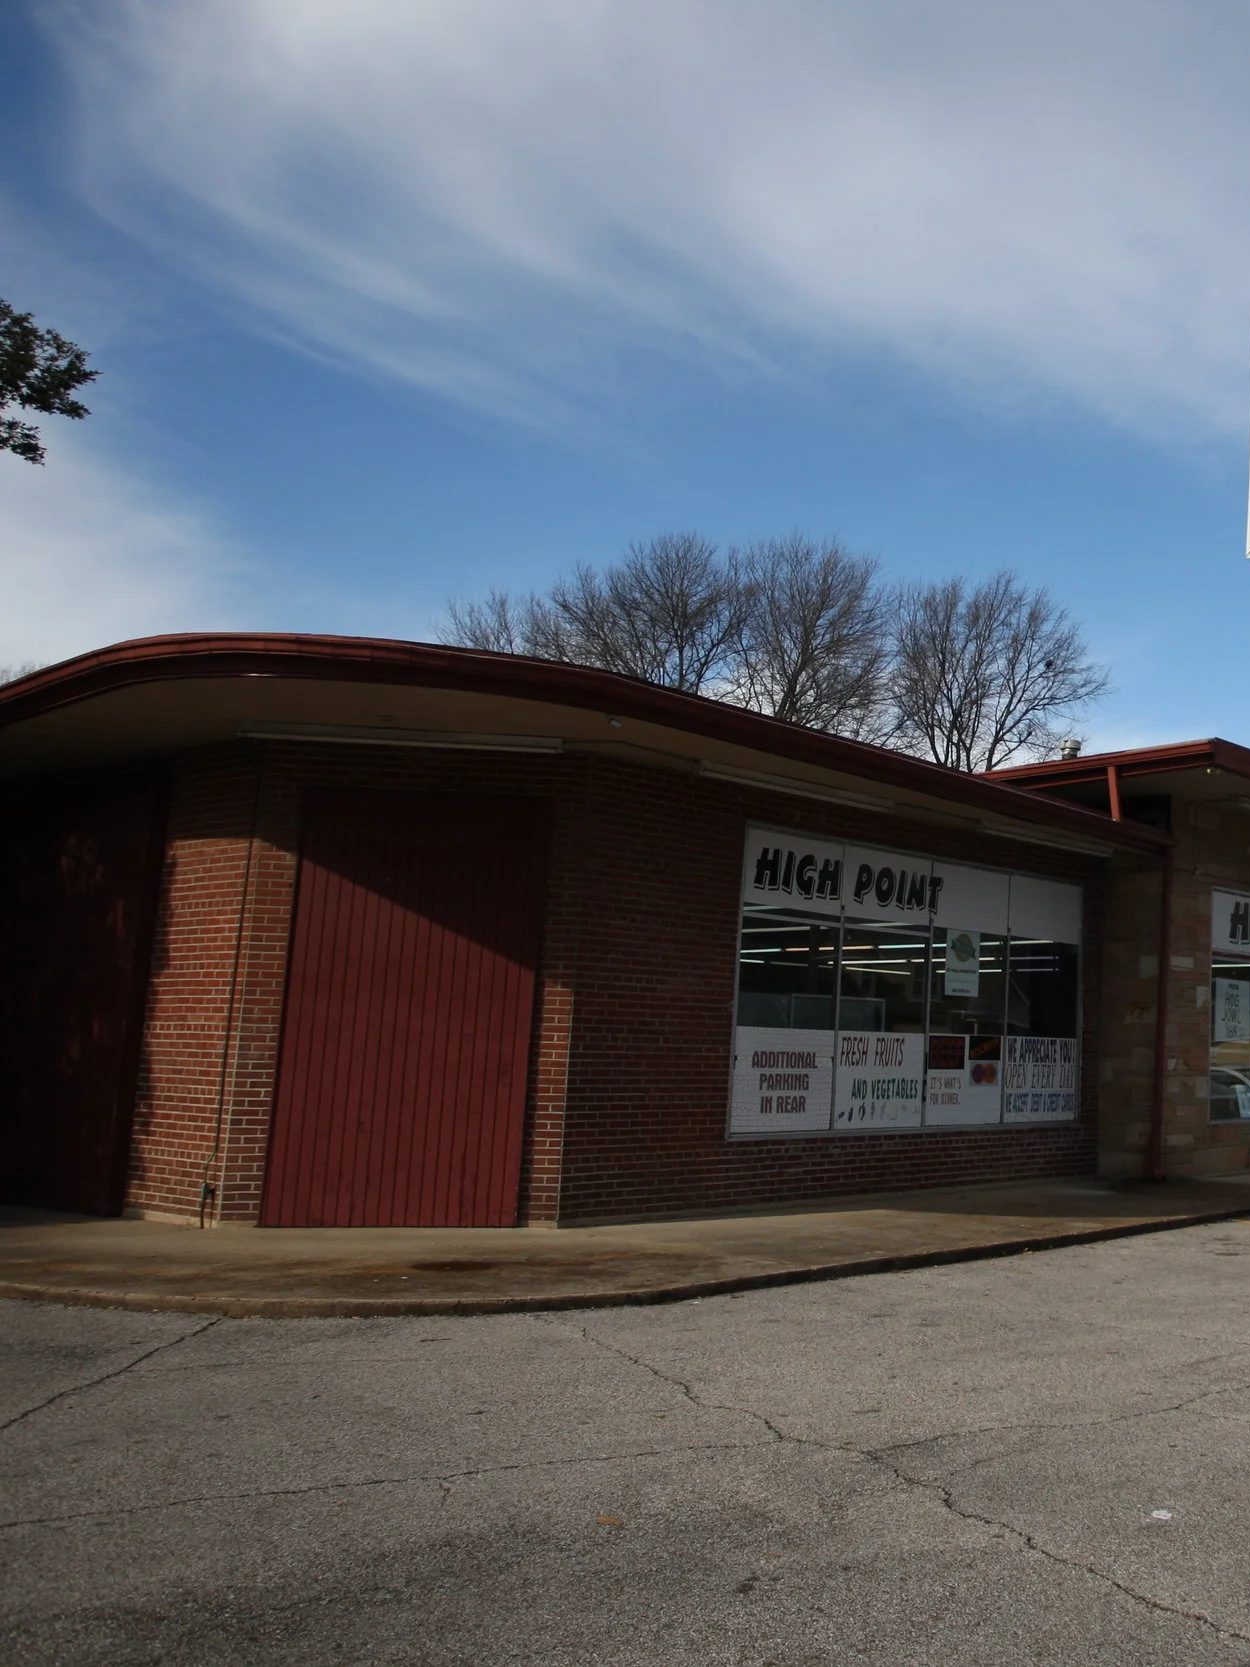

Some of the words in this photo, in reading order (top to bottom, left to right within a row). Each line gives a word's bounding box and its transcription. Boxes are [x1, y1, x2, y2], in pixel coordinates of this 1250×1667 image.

[753, 847, 843, 900] HIGH
[853, 863, 944, 915] POINT
[752, 1051, 818, 1069] ADDITIONAL
[839, 1036, 869, 1068] FRESH
[873, 1037, 905, 1068] FRUITS
[1007, 1037, 1017, 1063] WE
[1019, 1037, 1057, 1064] APPRECIATE
[759, 1073, 810, 1091] PARKING
[930, 1076, 942, 1089] IT'S
[1006, 1063, 1028, 1089] OPEN
[1031, 1064, 1056, 1089] EVERY
[1059, 1064, 1075, 1089] DAY
[851, 1078, 868, 1100] AND
[871, 1078, 918, 1100] VEGETABLES
[930, 1092, 939, 1105] FOR
[760, 1095, 772, 1114] IN
[776, 1095, 806, 1114] REAR
